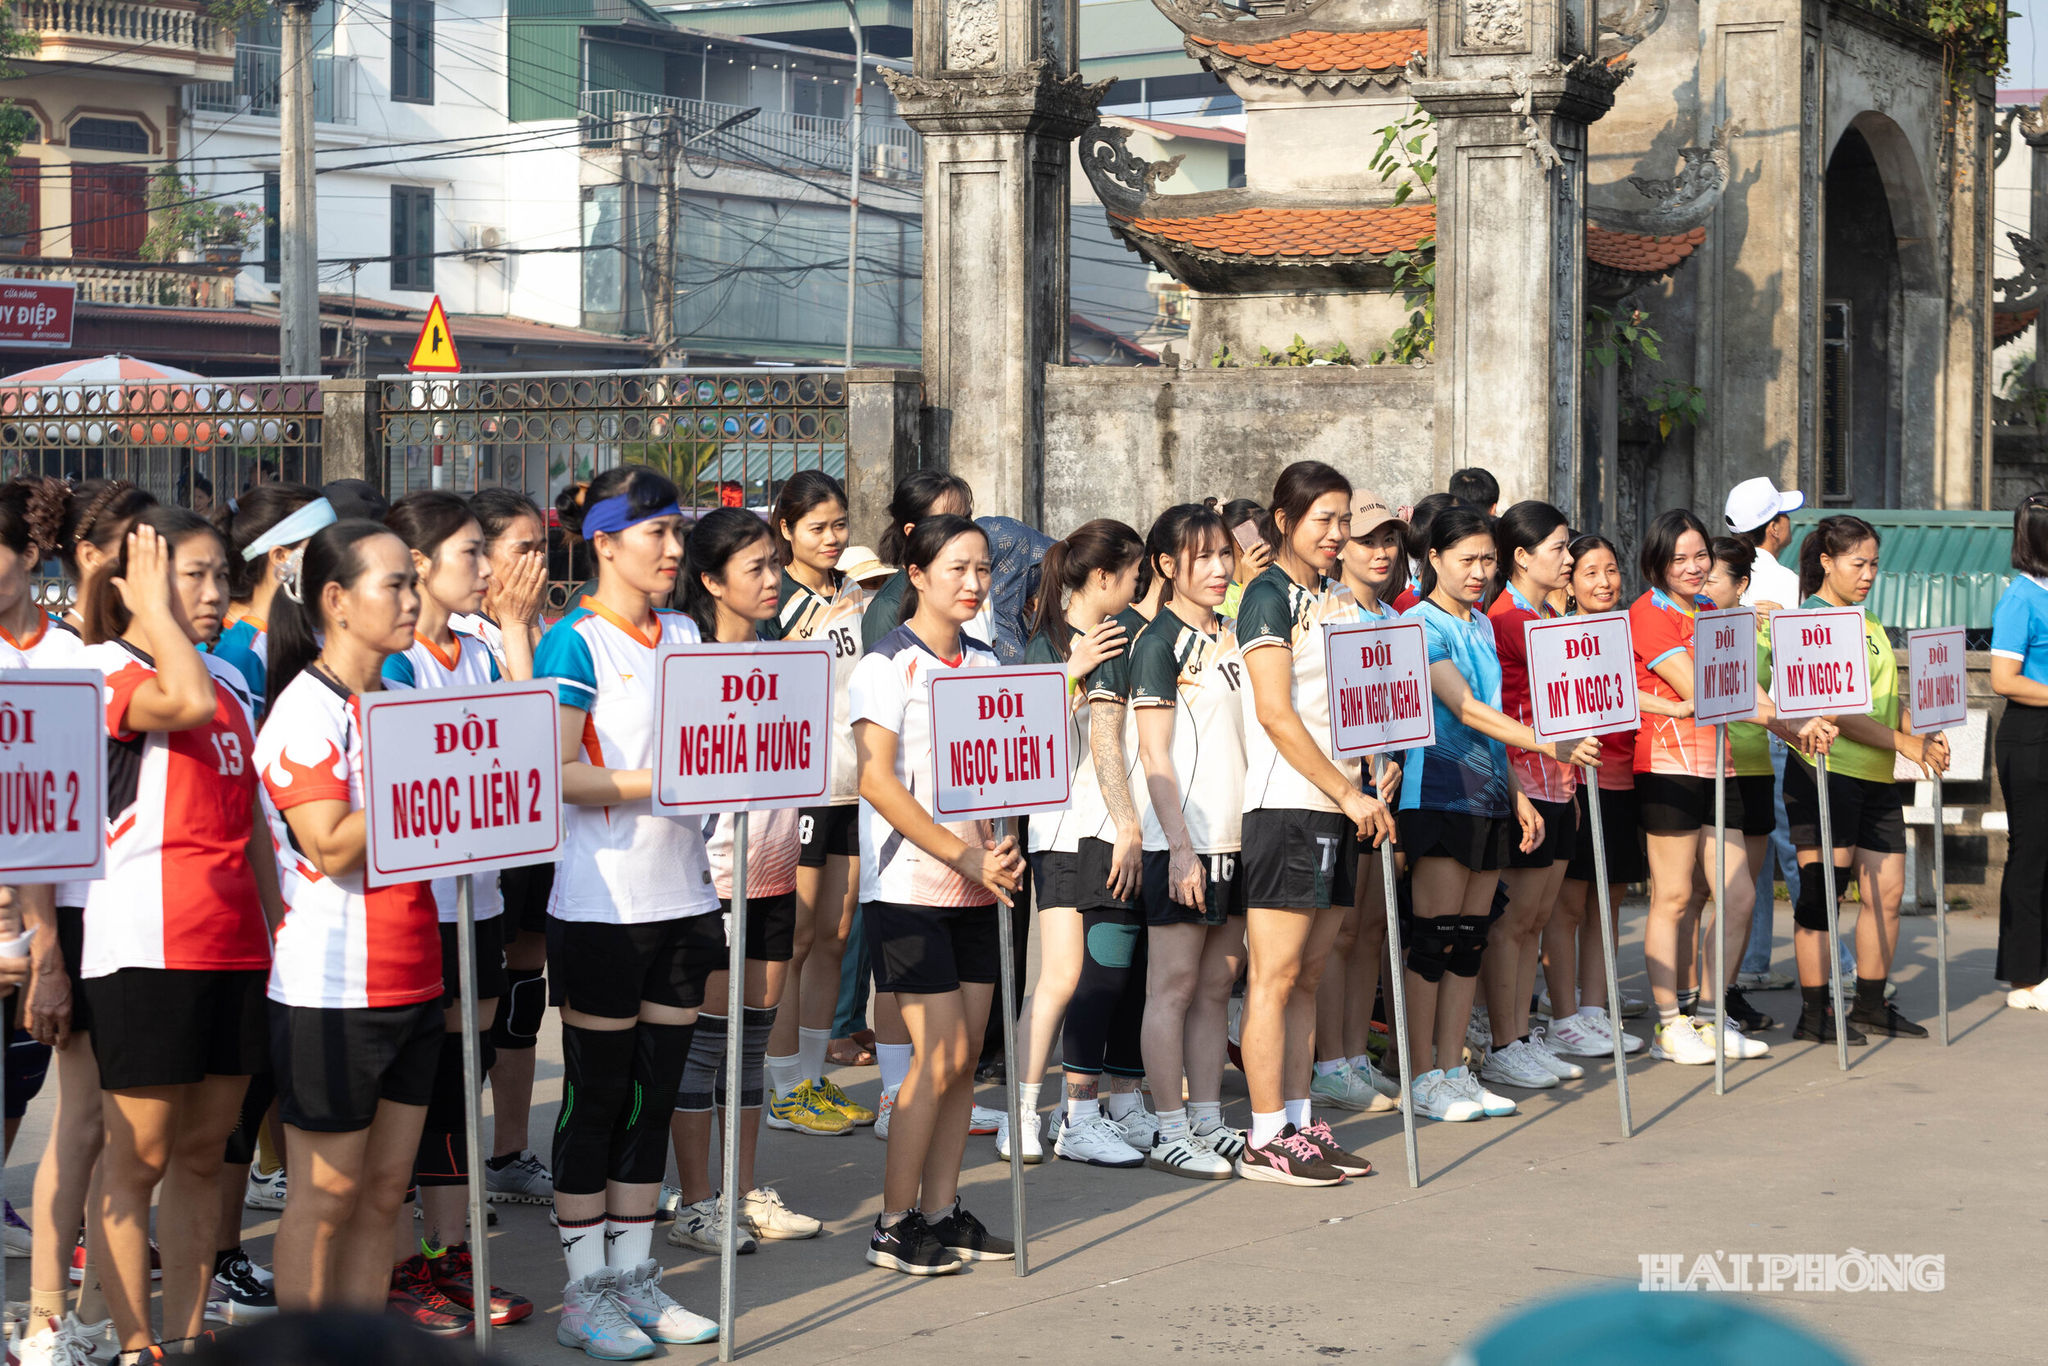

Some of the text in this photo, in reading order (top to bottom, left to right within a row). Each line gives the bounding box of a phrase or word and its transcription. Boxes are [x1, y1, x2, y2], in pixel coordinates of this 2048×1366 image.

[0, 302, 57, 331] Y ĐIỆP
[1361, 640, 1392, 671] ĐỘI
[1565, 632, 1601, 661] ĐỘI
[1715, 625, 1735, 652] ĐỘI
[1801, 624, 1832, 649] ĐỘI
[1929, 642, 1948, 667] ĐỘI
[720, 668, 779, 706] ĐỘI
[1339, 669, 1421, 732] BÌNH NGỌC NGHĨA
[1547, 671, 1624, 720] MỸ NGỌC 3
[1704, 657, 1747, 703] MỸ NGỌC 1
[1786, 657, 1855, 702] MỸ NGỌC 2
[1956, 673, 1960, 704] 1
[977, 688, 1025, 723] ĐỘI
[211, 731, 244, 776] 13
[433, 713, 499, 756] ĐỘI
[679, 711, 811, 776] NGHĨA HƯNG
[950, 725, 1055, 796] NGỌC LIÊN 1
[0, 762, 80, 835] ƯNG 2
[392, 758, 542, 848] NGỌC LIÊN 2
